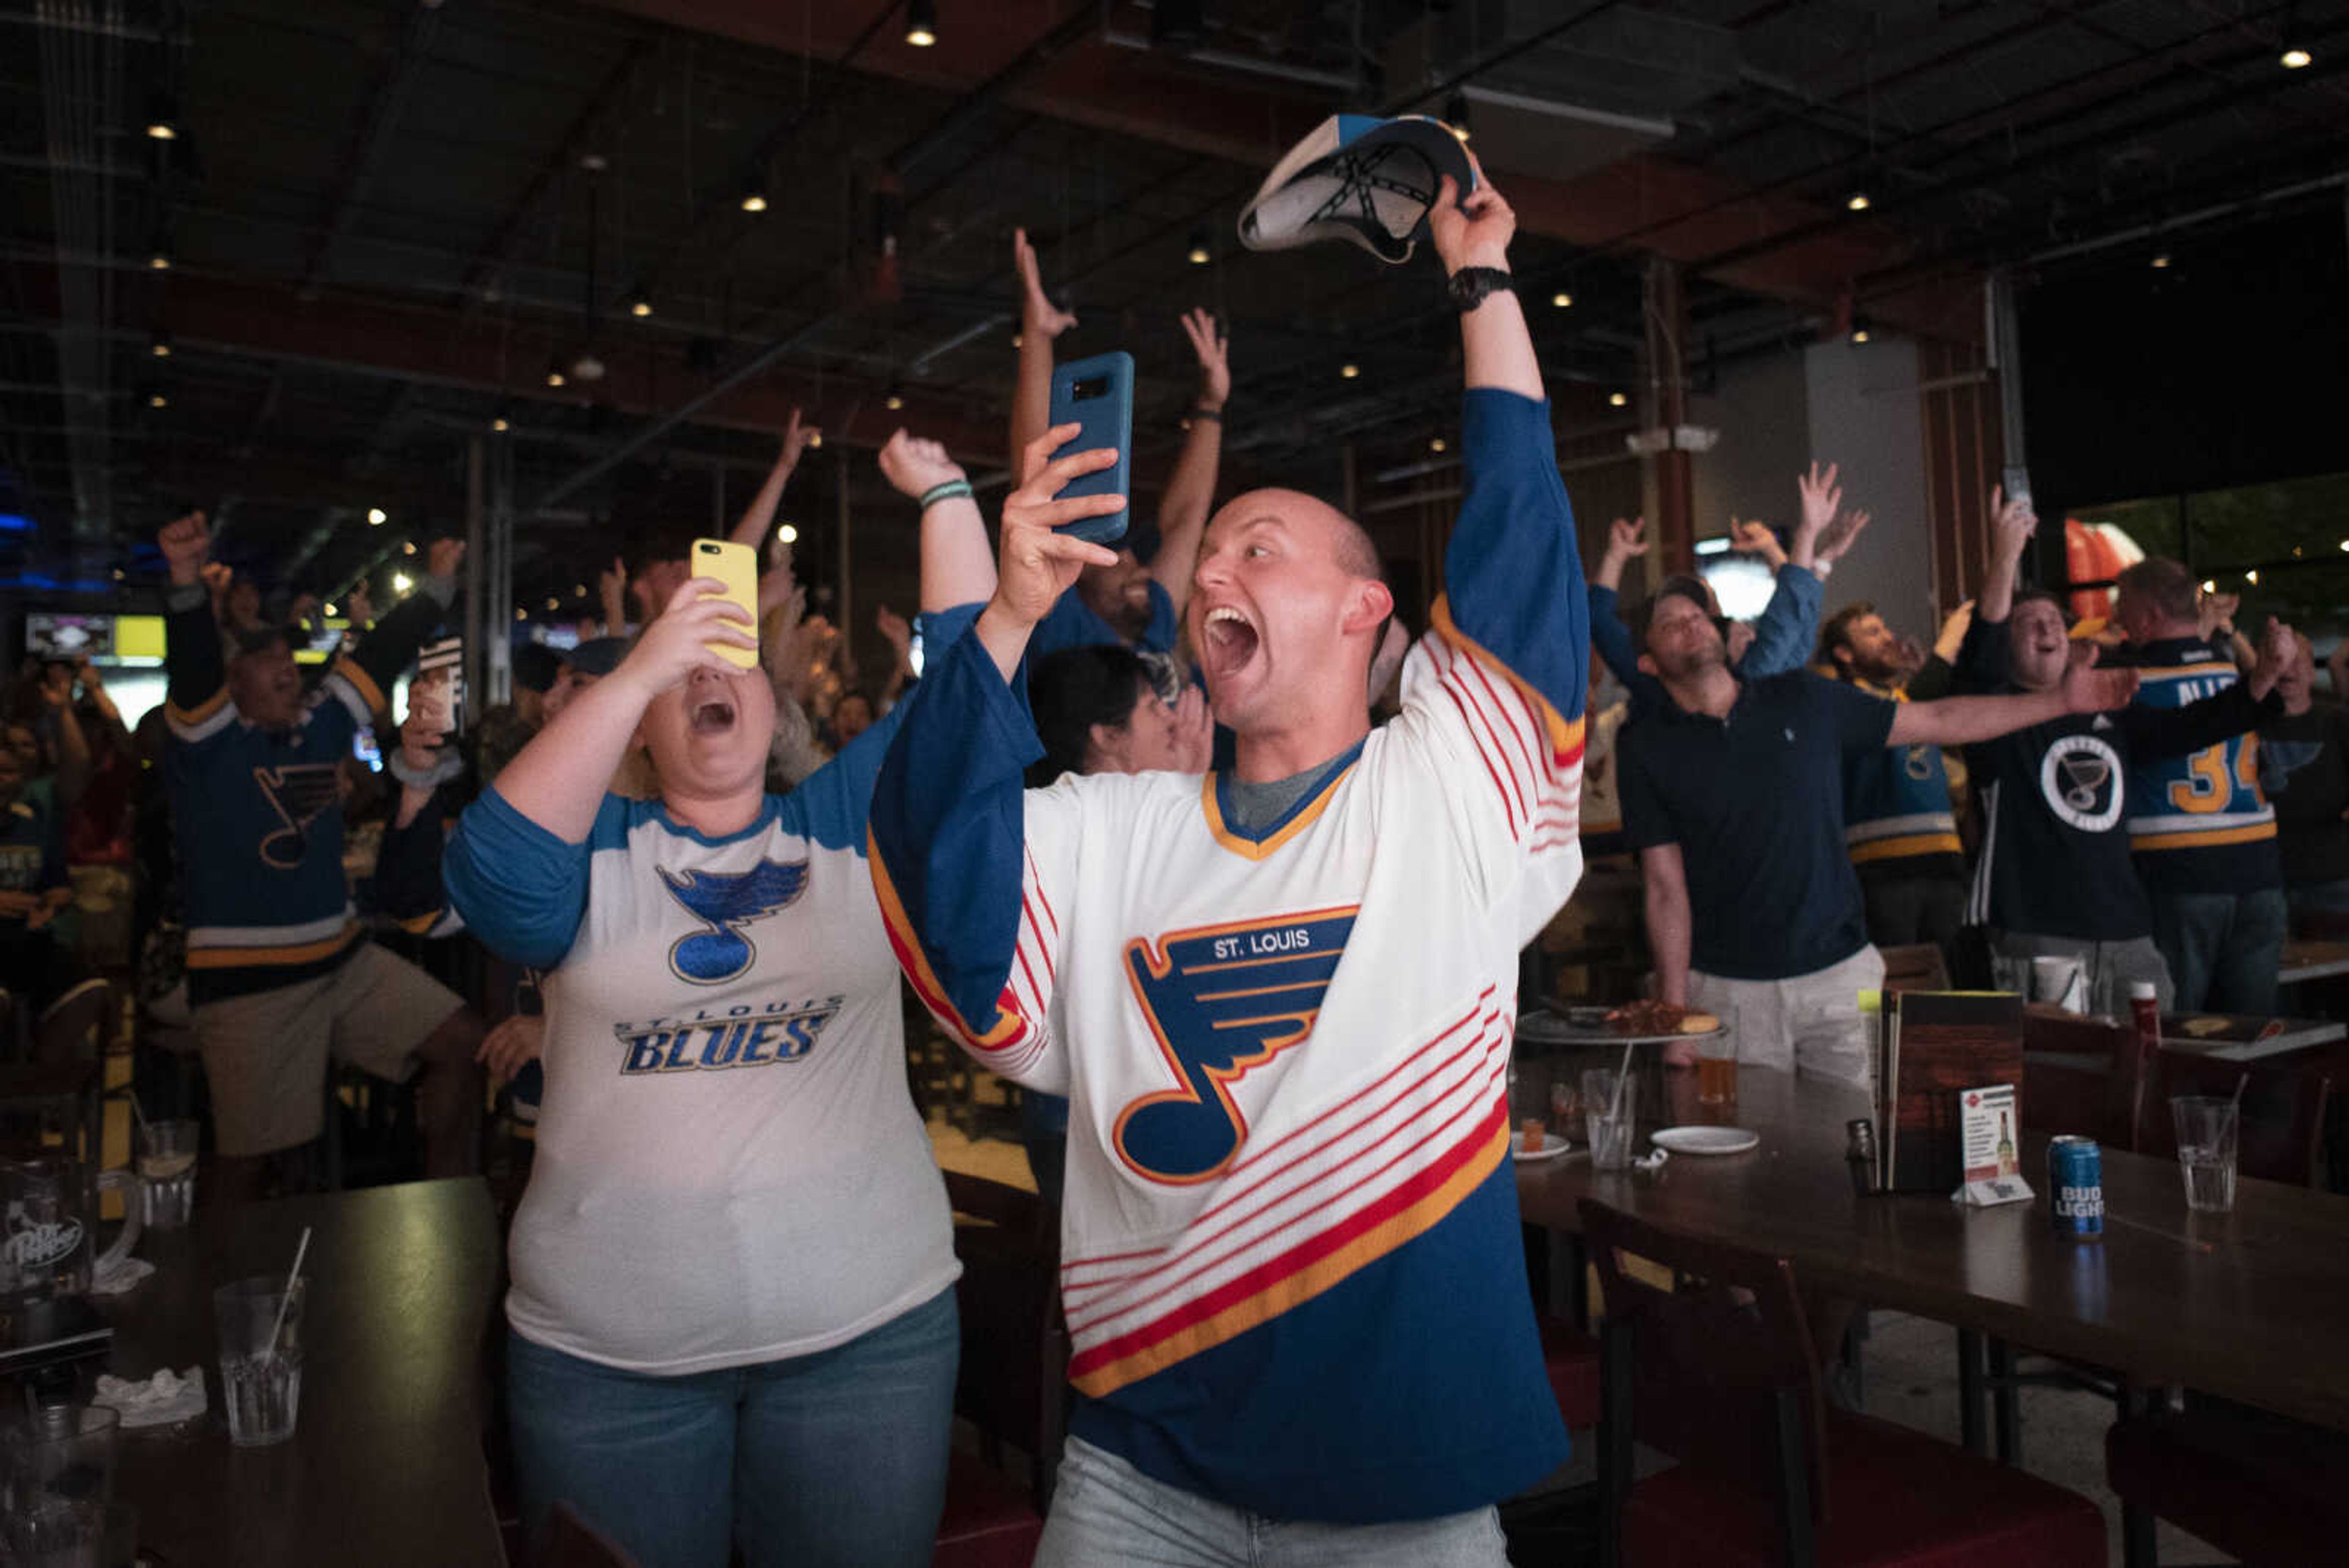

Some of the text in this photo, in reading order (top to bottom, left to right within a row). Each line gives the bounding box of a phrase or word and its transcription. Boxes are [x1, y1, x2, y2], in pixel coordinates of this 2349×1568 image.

[1214, 928, 1310, 959] ST. LOUIS
[696, 994, 847, 1021] LOUIS
[621, 1008, 836, 1074] BLUES
[2061, 1186, 2102, 1201] BUD
